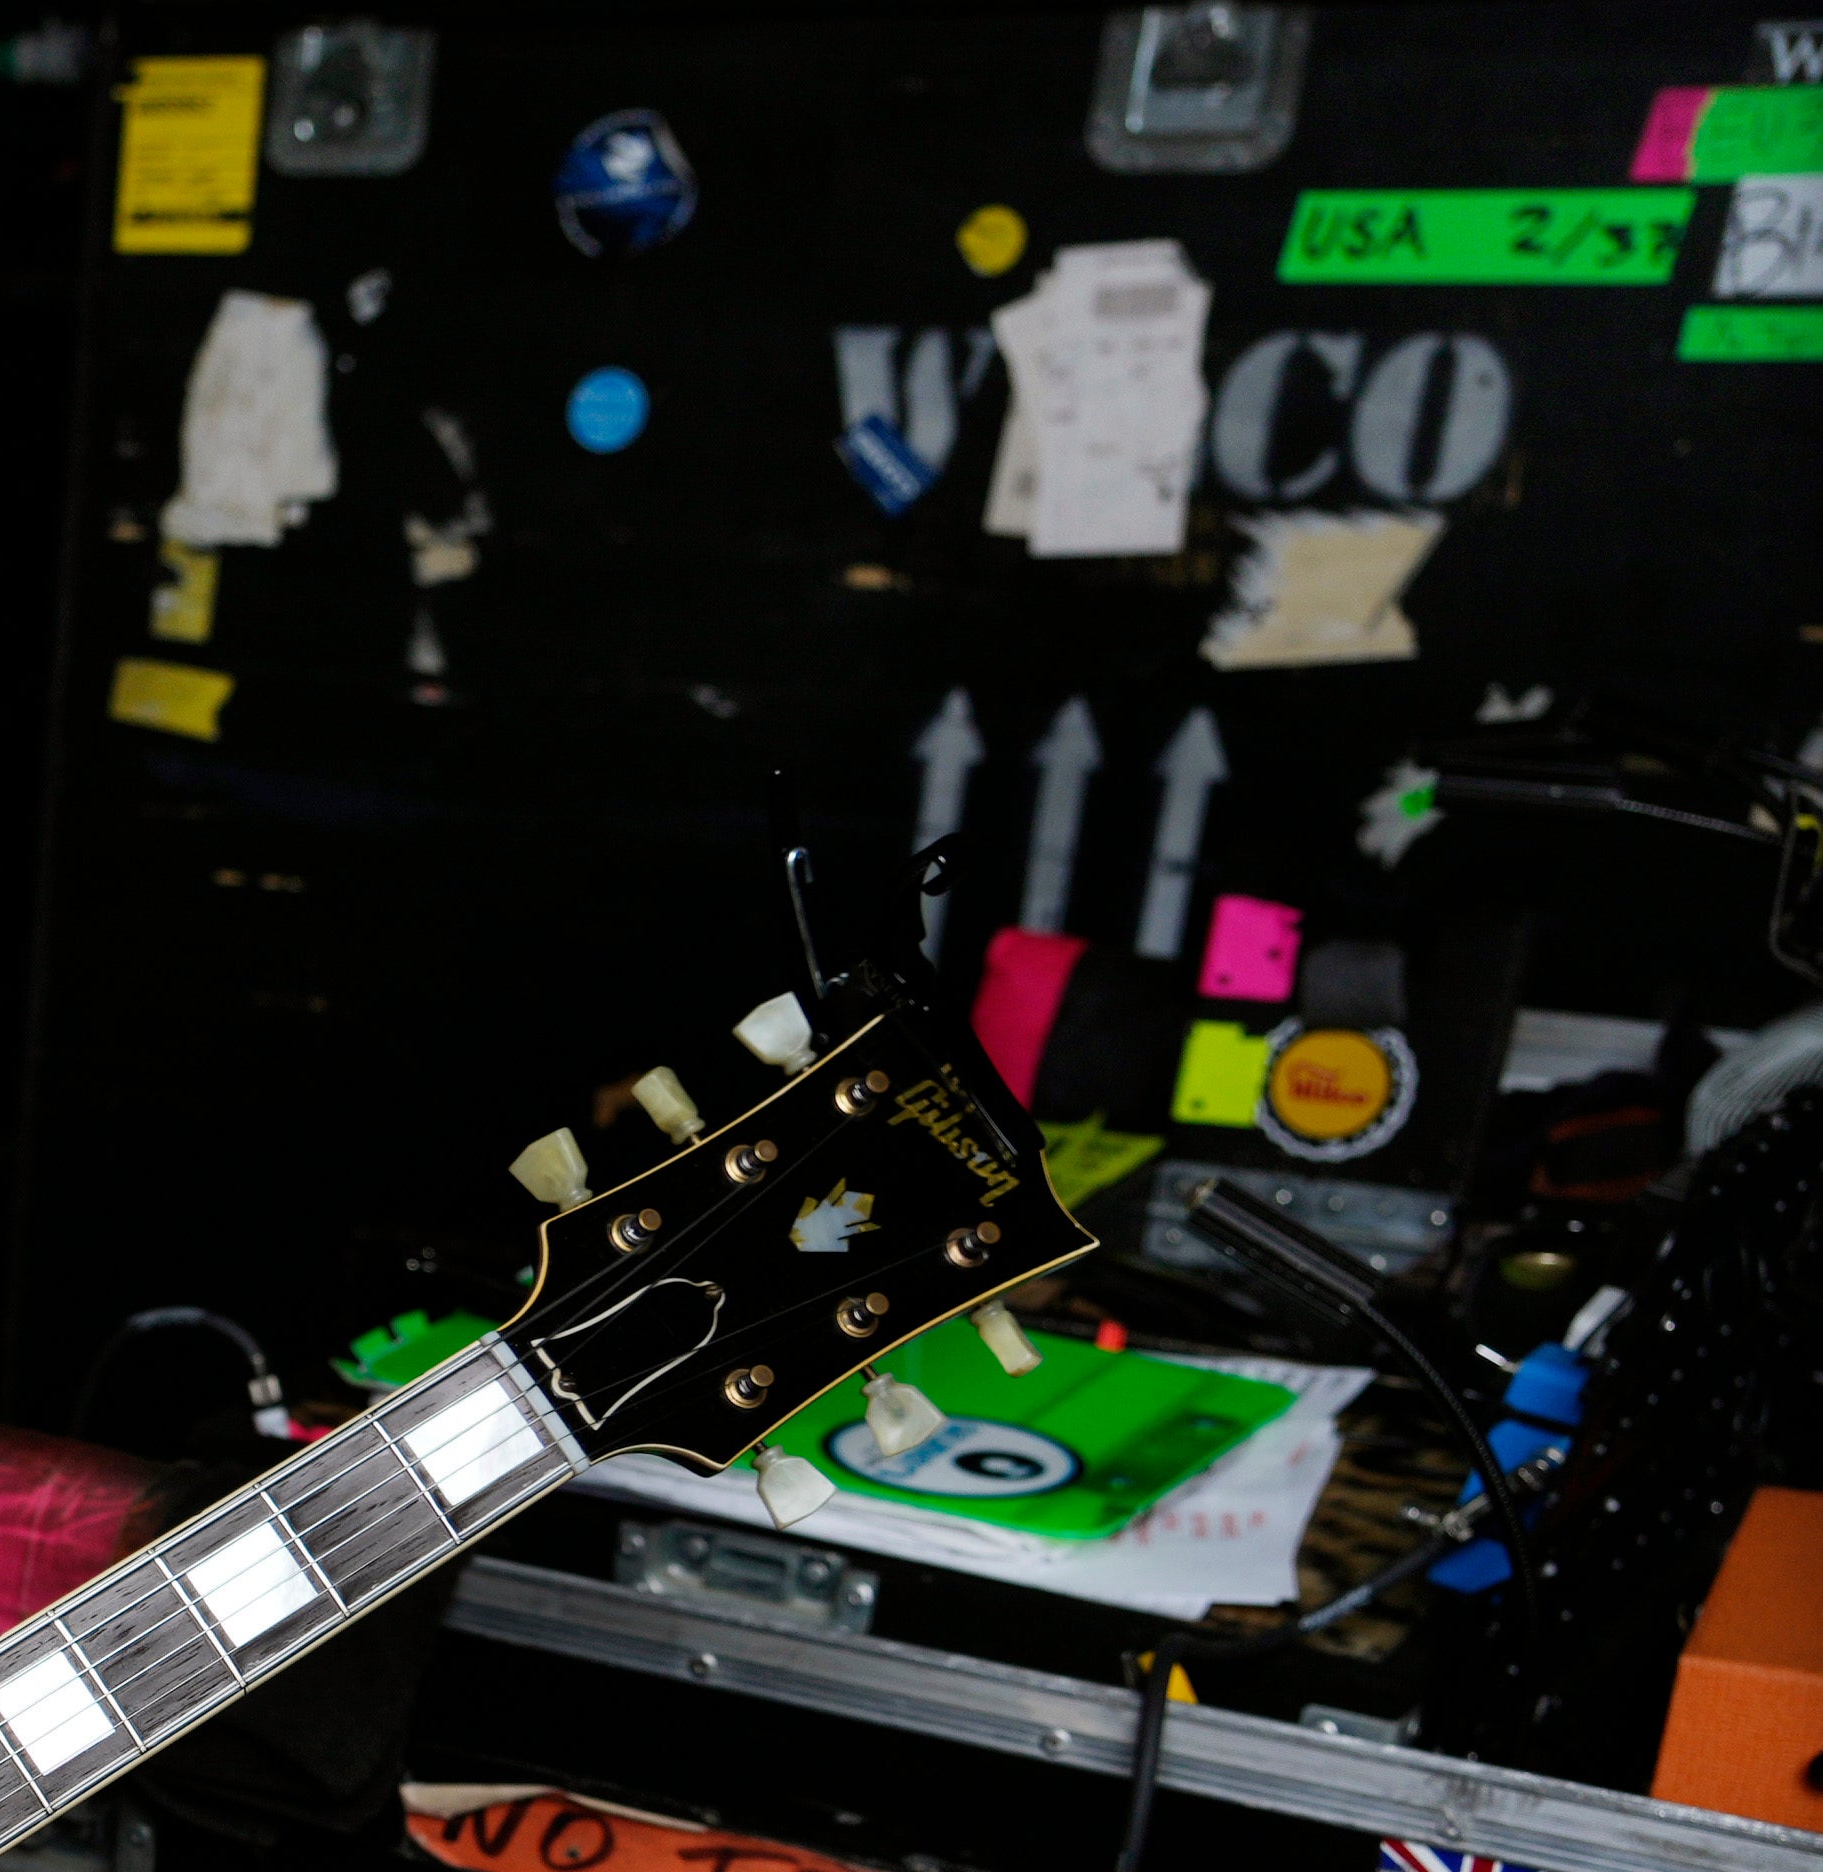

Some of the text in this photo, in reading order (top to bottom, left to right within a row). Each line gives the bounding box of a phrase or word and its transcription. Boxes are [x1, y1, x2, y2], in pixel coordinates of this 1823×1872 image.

[1299, 205, 1426, 262] USA
[834, 328, 1511, 503] WCO
[885, 1079, 1021, 1208] Gibson
[443, 1797, 614, 1872] NO
